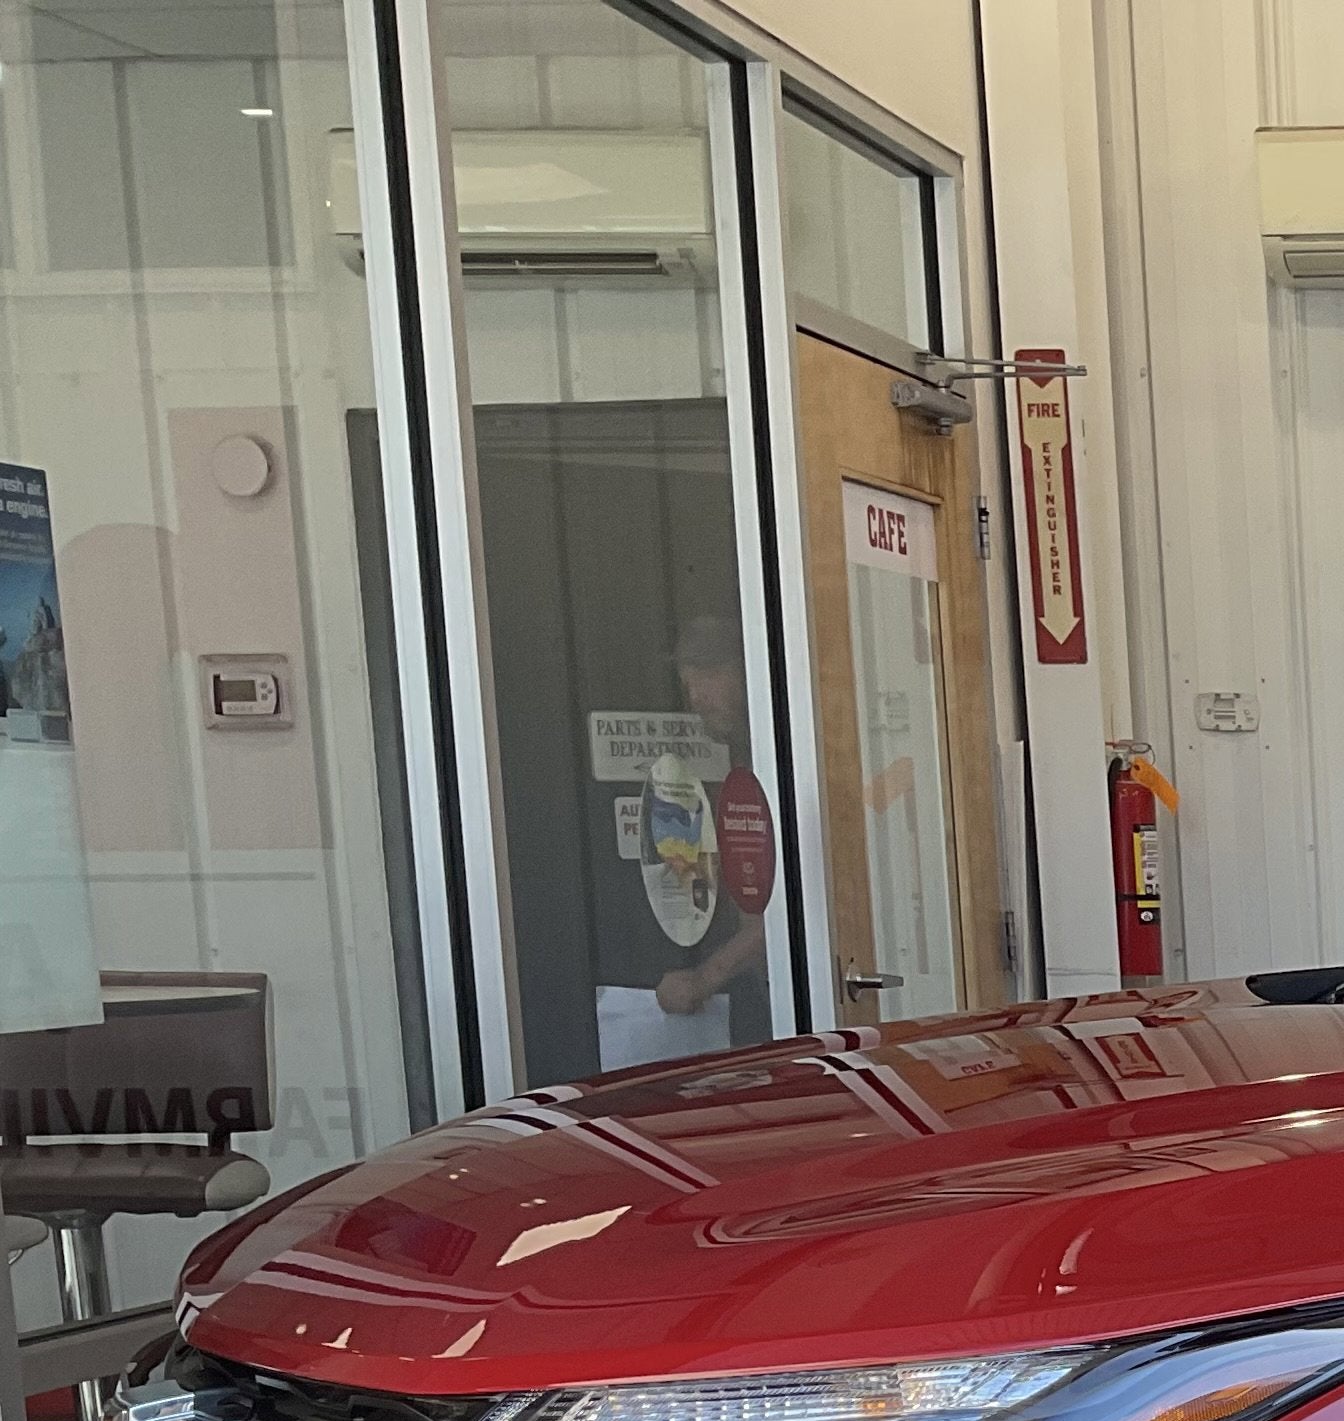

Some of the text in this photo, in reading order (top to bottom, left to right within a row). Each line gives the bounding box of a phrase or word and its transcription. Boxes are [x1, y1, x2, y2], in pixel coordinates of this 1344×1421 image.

[1027, 403, 1060, 418] FIRE
[1042, 442, 1062, 596] EXTINGUISHER
[867, 504, 907, 556] CAFE
[596, 719, 641, 736] PARTS
[609, 741, 712, 759] DEPARTMENTS
